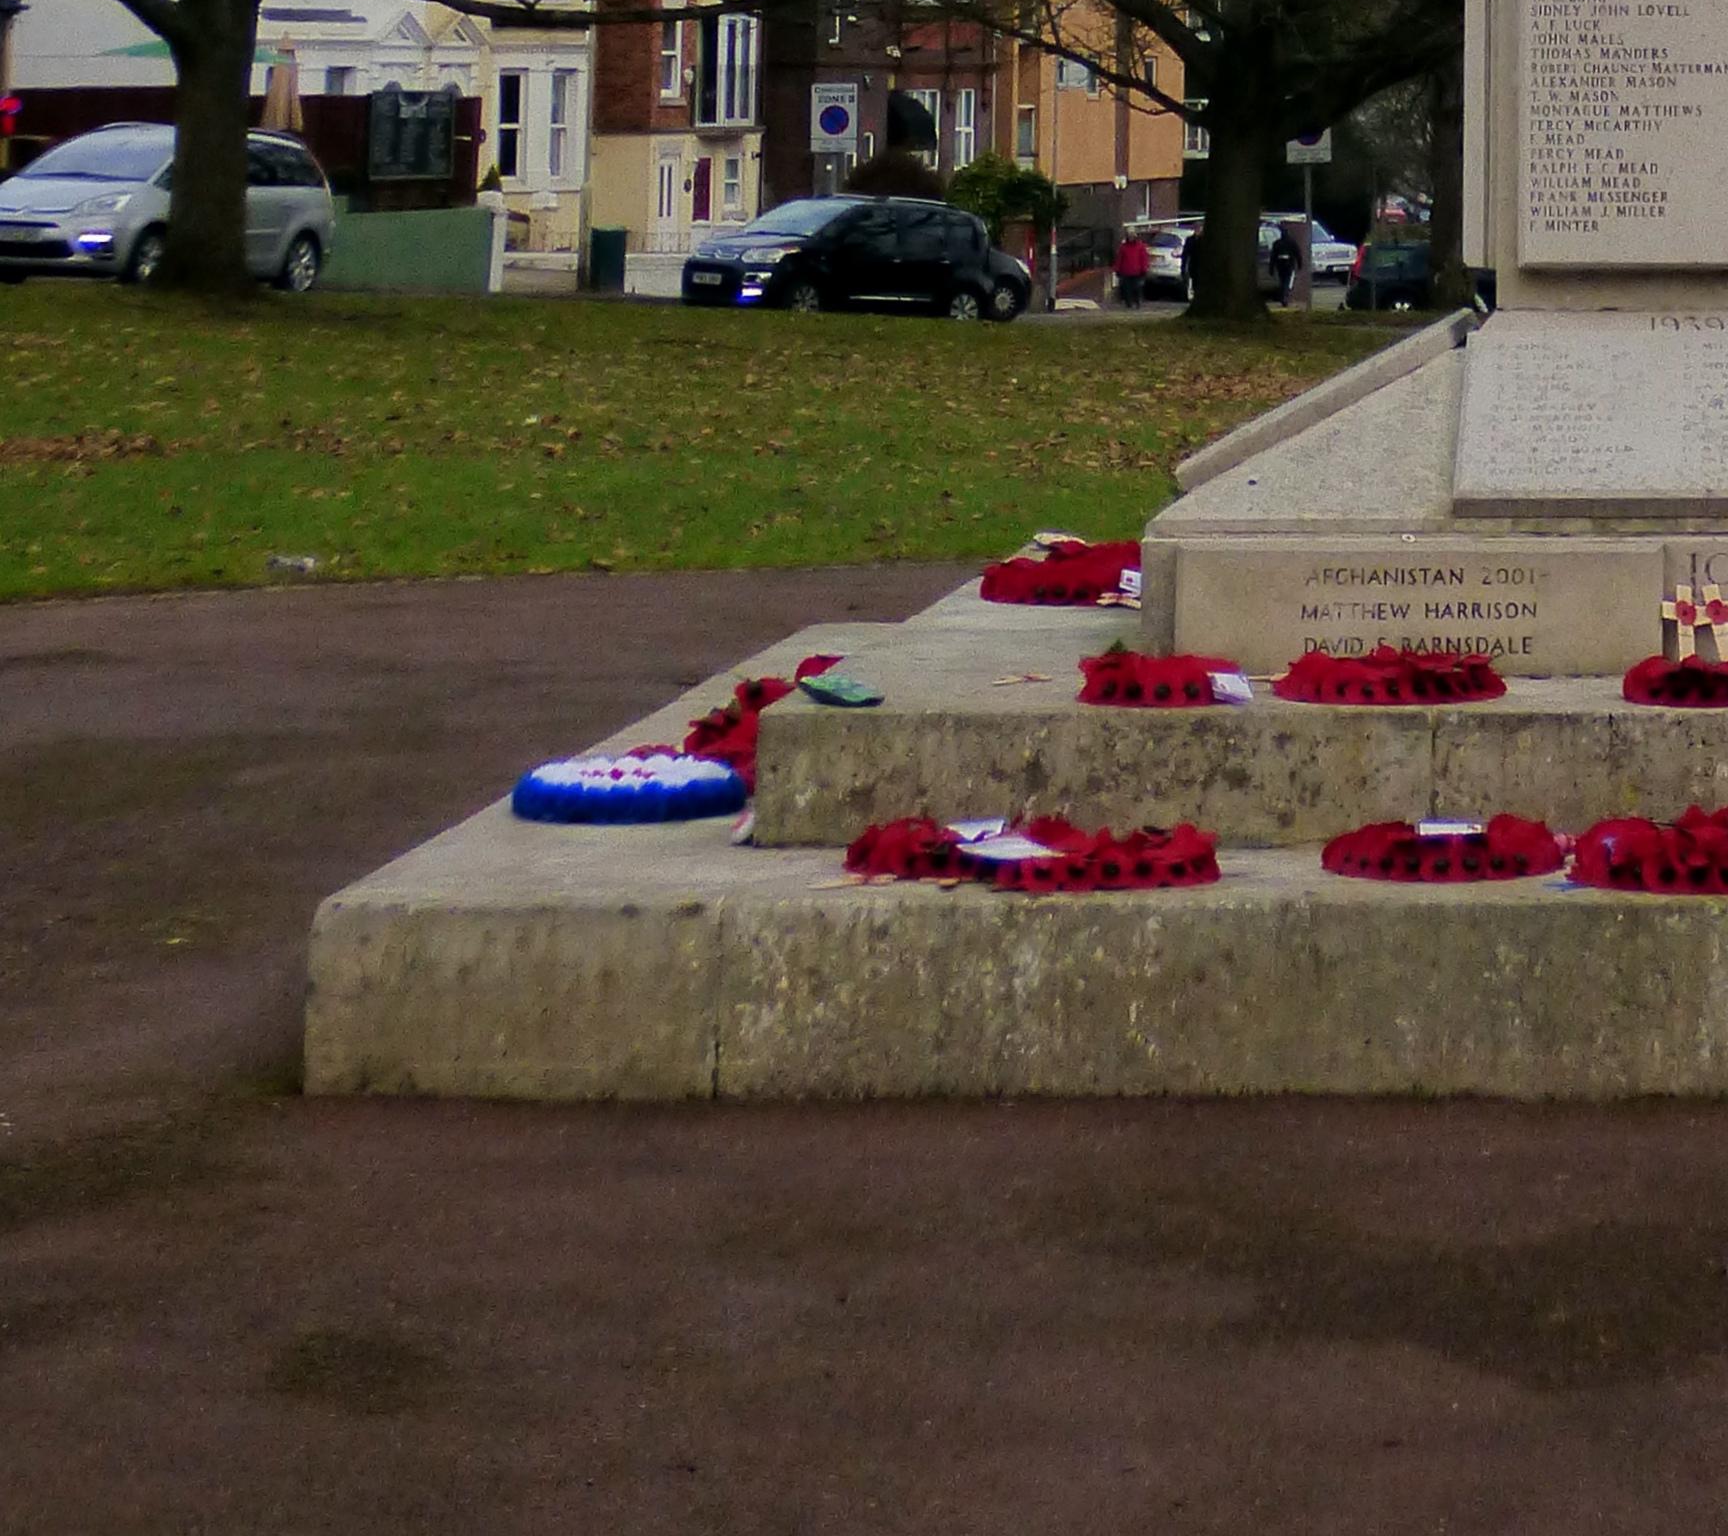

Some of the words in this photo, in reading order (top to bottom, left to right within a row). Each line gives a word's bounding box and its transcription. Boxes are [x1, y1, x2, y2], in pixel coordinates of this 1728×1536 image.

[1530, 5, 1580, 16] SIDNEY
[1591, 5, 1629, 16] JOHN
[1638, 5, 1689, 16] LOVELL
[1565, 20, 1600, 31] LUCK
[1532, 34, 1568, 45] JOHN
[1531, 48, 1591, 59] THOMAS
[1601, 48, 1668, 59] MANDERS
[1531, 62, 1576, 74] ROBERT
[1531, 77, 1615, 87] ALEXANDER
[1626, 77, 1676, 87] MASON
[1570, 91, 1618, 102] MASON
[1530, 106, 1609, 116] MONTAGUE
[1620, 106, 1701, 116] MATTHEWS
[1530, 120, 1573, 131] PERCY
[1546, 134, 1584, 145] MEAD
[1530, 149, 1573, 159] PERCY
[1584, 149, 1623, 159] MEAD
[1530, 163, 1576, 173] RALPH
[1619, 163, 1658, 173] MEAD
[1531, 177, 1591, 188] WILLIAM
[1602, 177, 1640, 188] MEAD
[1530, 192, 1576, 203] FRANK
[1587, 192, 1667, 203] MESSENGER
[1531, 206, 1591, 217] WILLIAM
[1617, 206, 1665, 217] MILLER
[1545, 221, 1599, 232] MINTER
[1651, 316, 1725, 332] 1939
[1305, 568, 1465, 585] AFGHANISTAN
[1301, 602, 1410, 620] MATTHEW
[1425, 602, 1537, 620] HARRISON
[1305, 636, 1363, 655] DAVID
[1401, 636, 1534, 655] BARNSDALE
